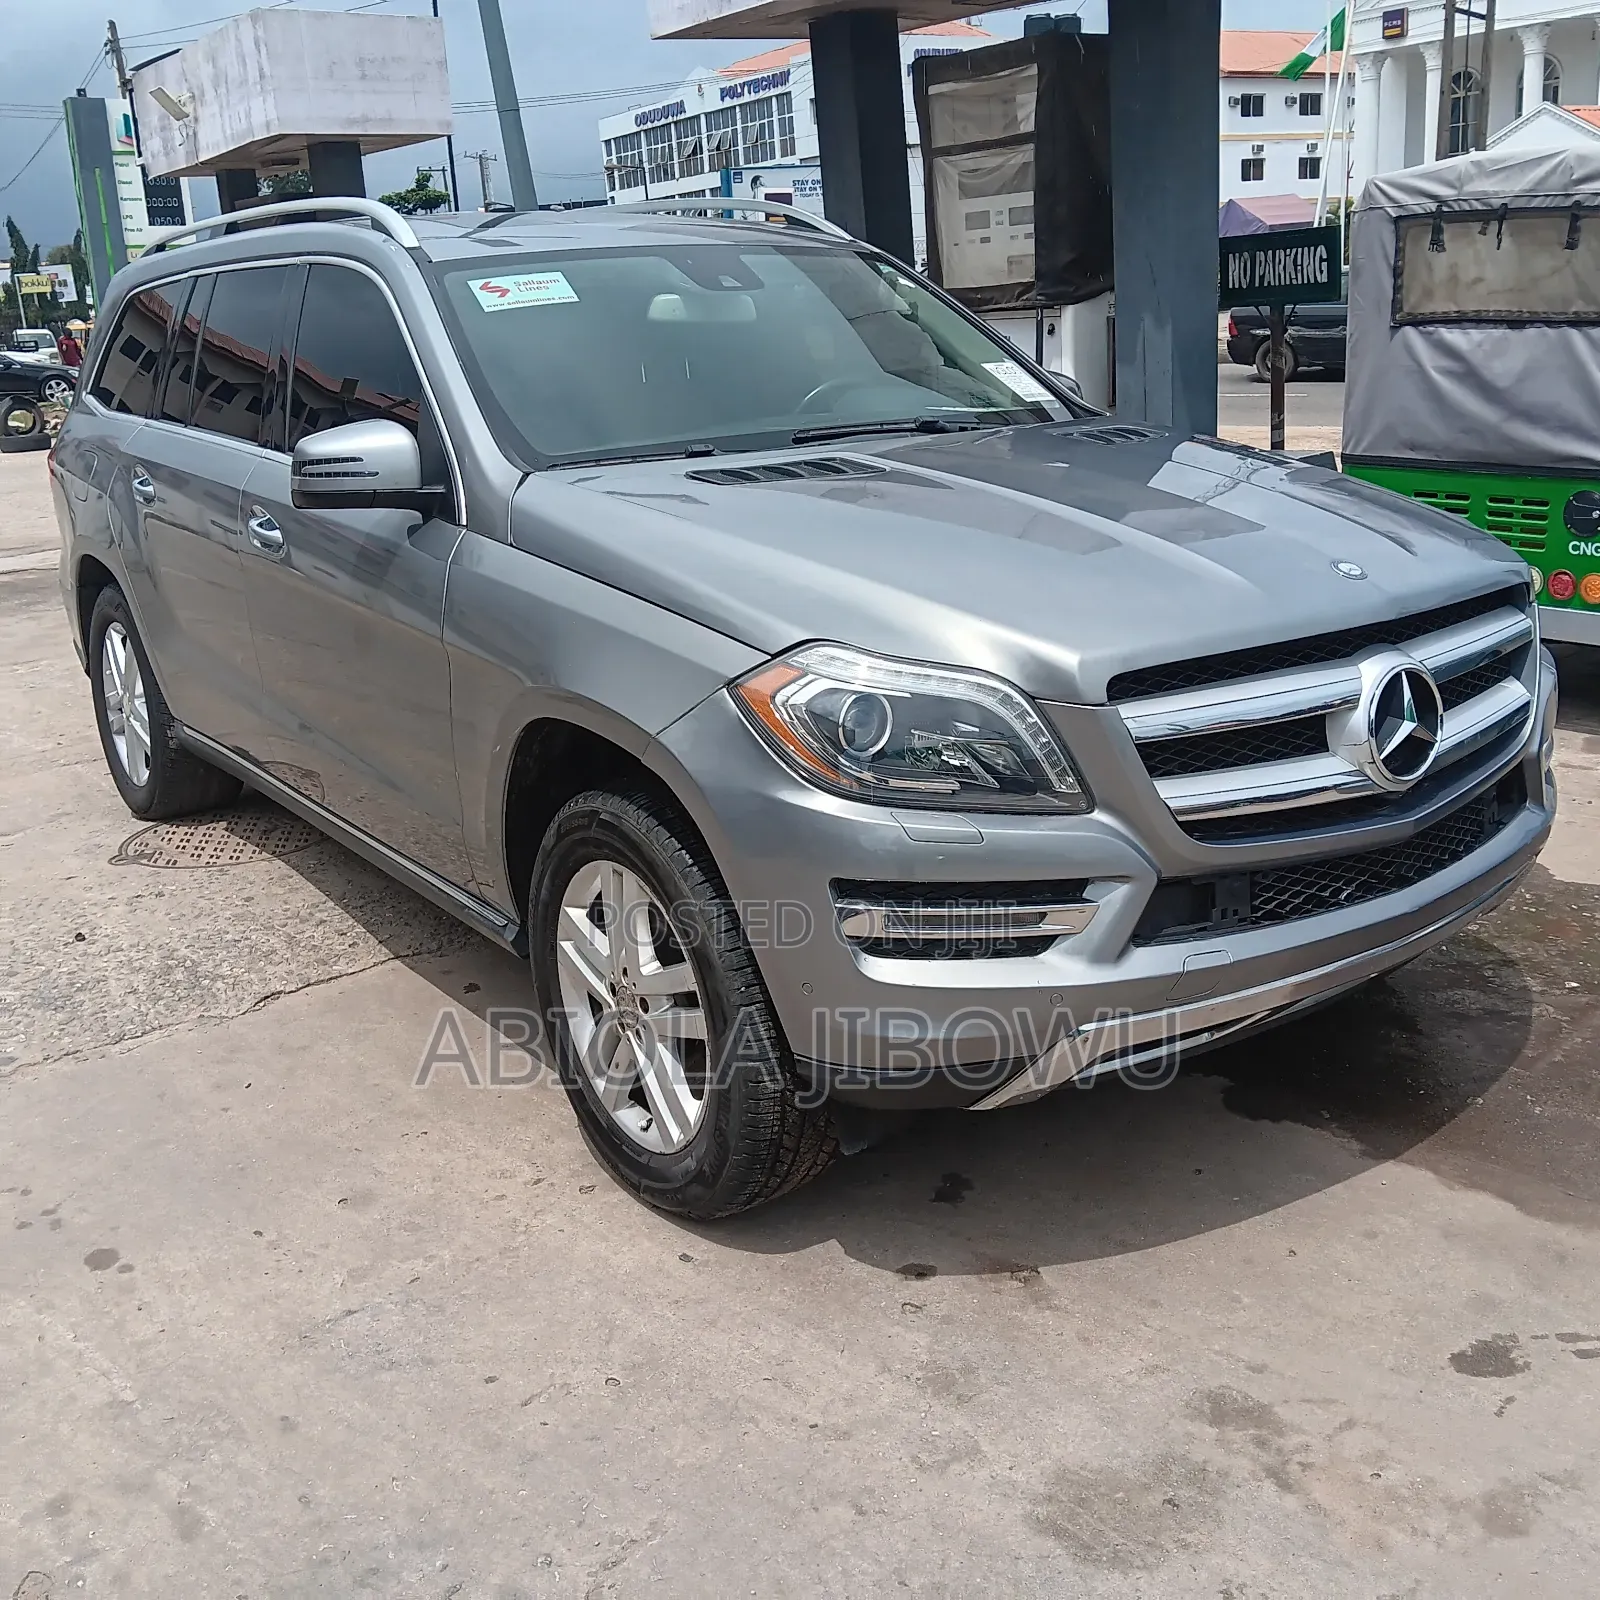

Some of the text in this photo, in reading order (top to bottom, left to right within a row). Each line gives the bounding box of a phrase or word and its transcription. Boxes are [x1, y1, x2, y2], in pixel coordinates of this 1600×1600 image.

[634, 99, 687, 128] ODUDUWA
[1228, 245, 1328, 289] NO PARKING
[513, 278, 560, 287] Sallaum
[517, 285, 550, 293] Lines
[1568, 540, 1600, 557] CNG
